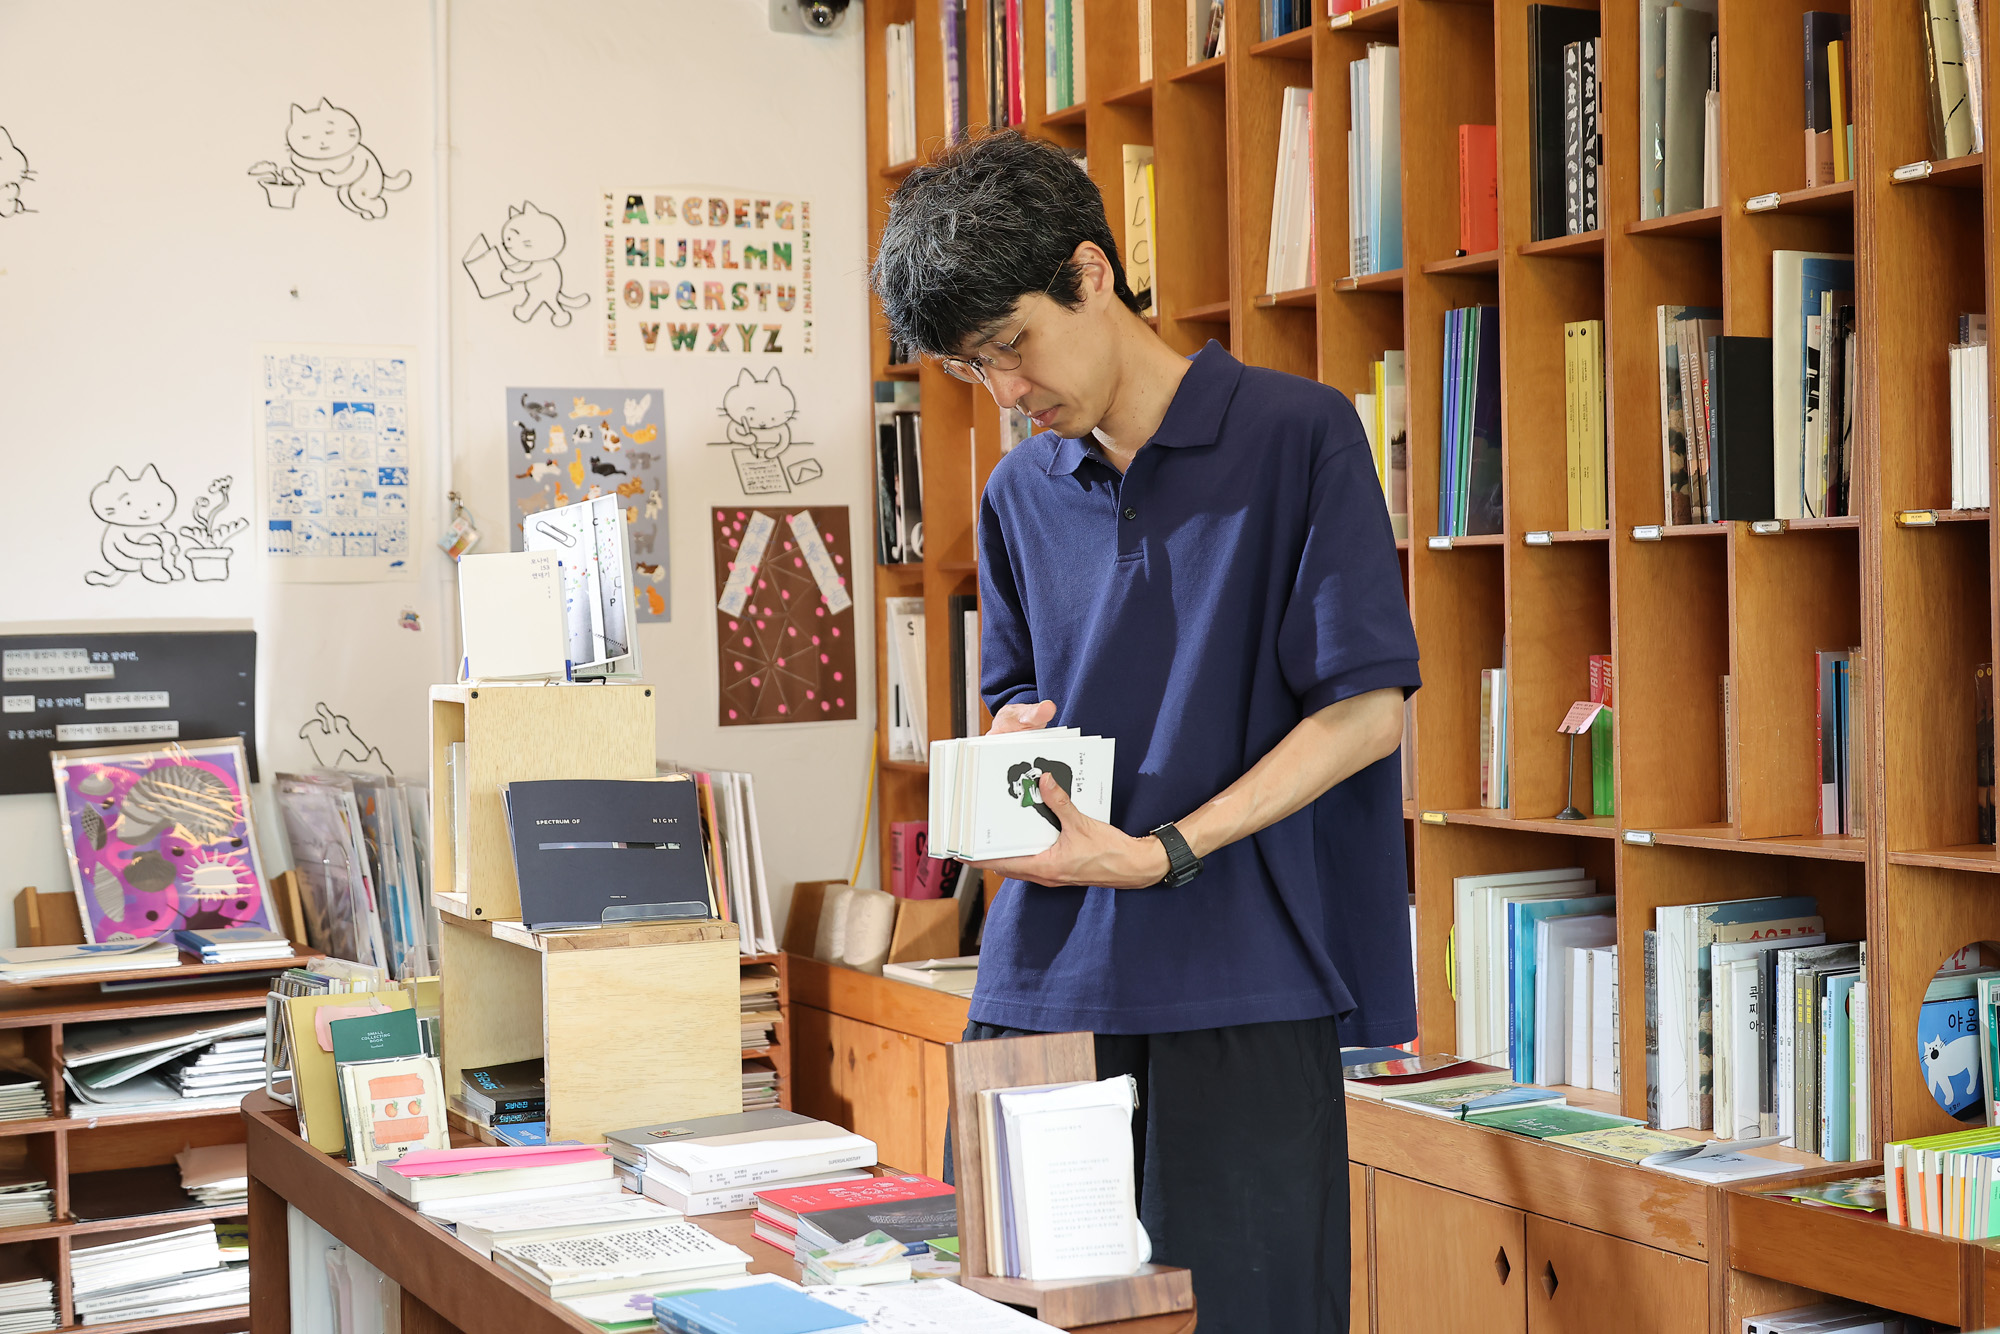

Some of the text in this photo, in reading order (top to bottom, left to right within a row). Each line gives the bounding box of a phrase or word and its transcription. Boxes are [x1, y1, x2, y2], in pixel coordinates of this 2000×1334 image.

[1679, 353, 1689, 392] Killing
[1689, 352, 1706, 460] Killing and Dying
[361, 1033, 391, 1041] COLLECTING
